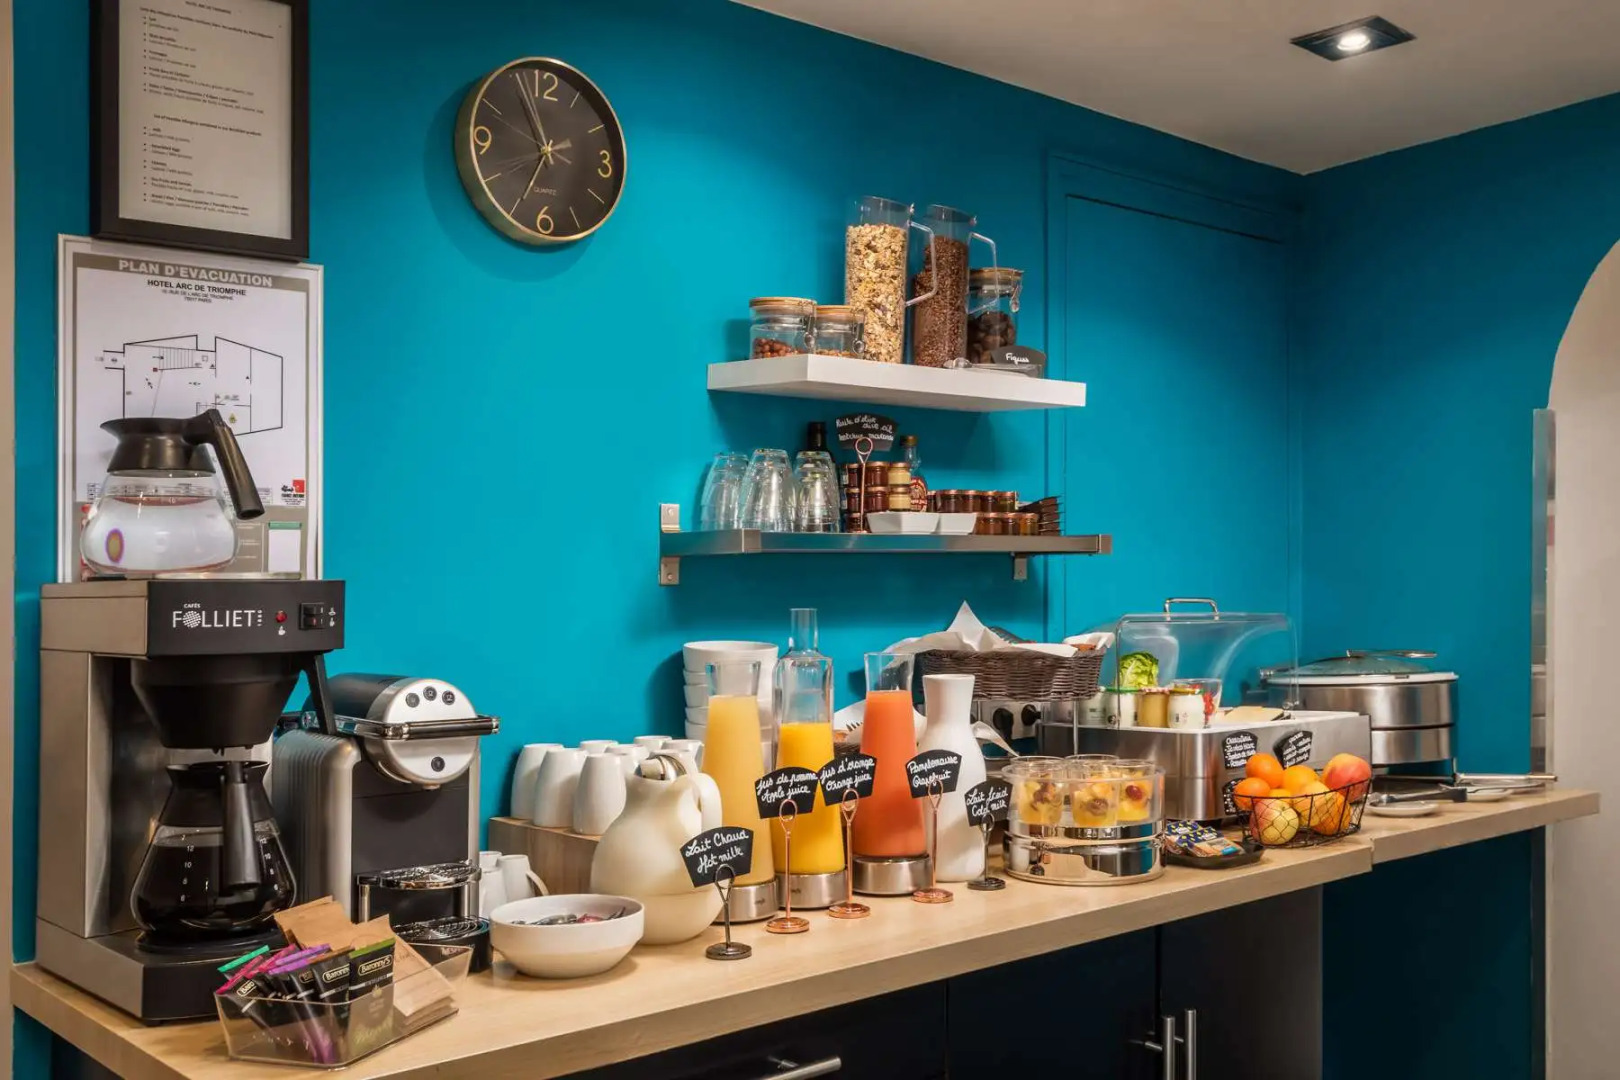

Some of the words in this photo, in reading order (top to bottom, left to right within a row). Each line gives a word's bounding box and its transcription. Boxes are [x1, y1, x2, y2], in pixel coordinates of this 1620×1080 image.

[534, 70, 558, 102] 12
[474, 126, 492, 155] 9
[598, 150, 612, 178] 3
[534, 186, 557, 196] QUARTZ
[536, 206, 554, 234] 6
[118, 260, 160, 275] PLAN
[164, 266, 273, 288] D'EVACUATION
[148, 279, 174, 288] HOTEL
[176, 282, 192, 290] ARC
[208, 286, 246, 296] TRIOMPHE
[786, 784, 811, 800] juice
[854, 770, 872, 788] juice
[686, 840, 712, 858] Lait
[714, 830, 750, 846] Chaud
[697, 854, 718, 874] Hot
[718, 846, 744, 862] milk
